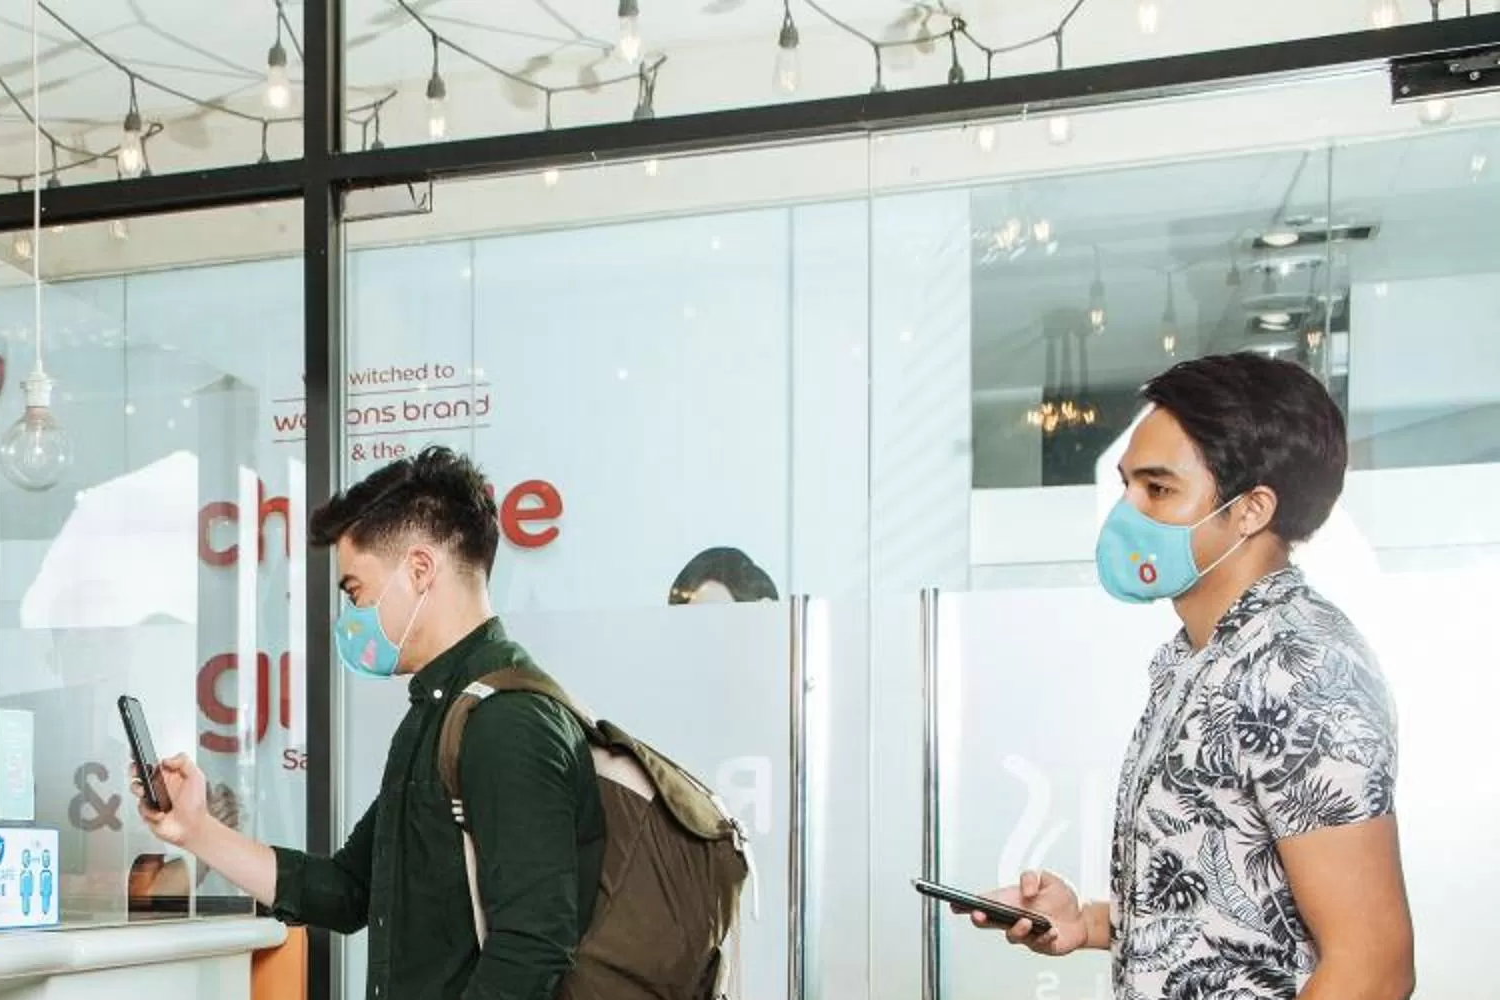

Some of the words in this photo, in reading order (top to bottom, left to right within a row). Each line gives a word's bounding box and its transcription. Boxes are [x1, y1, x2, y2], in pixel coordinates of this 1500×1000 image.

[350, 364, 428, 385] witched
[434, 363, 455, 380] to
[403, 394, 490, 422] brand
[351, 443, 366, 461] &
[373, 441, 406, 460] the
